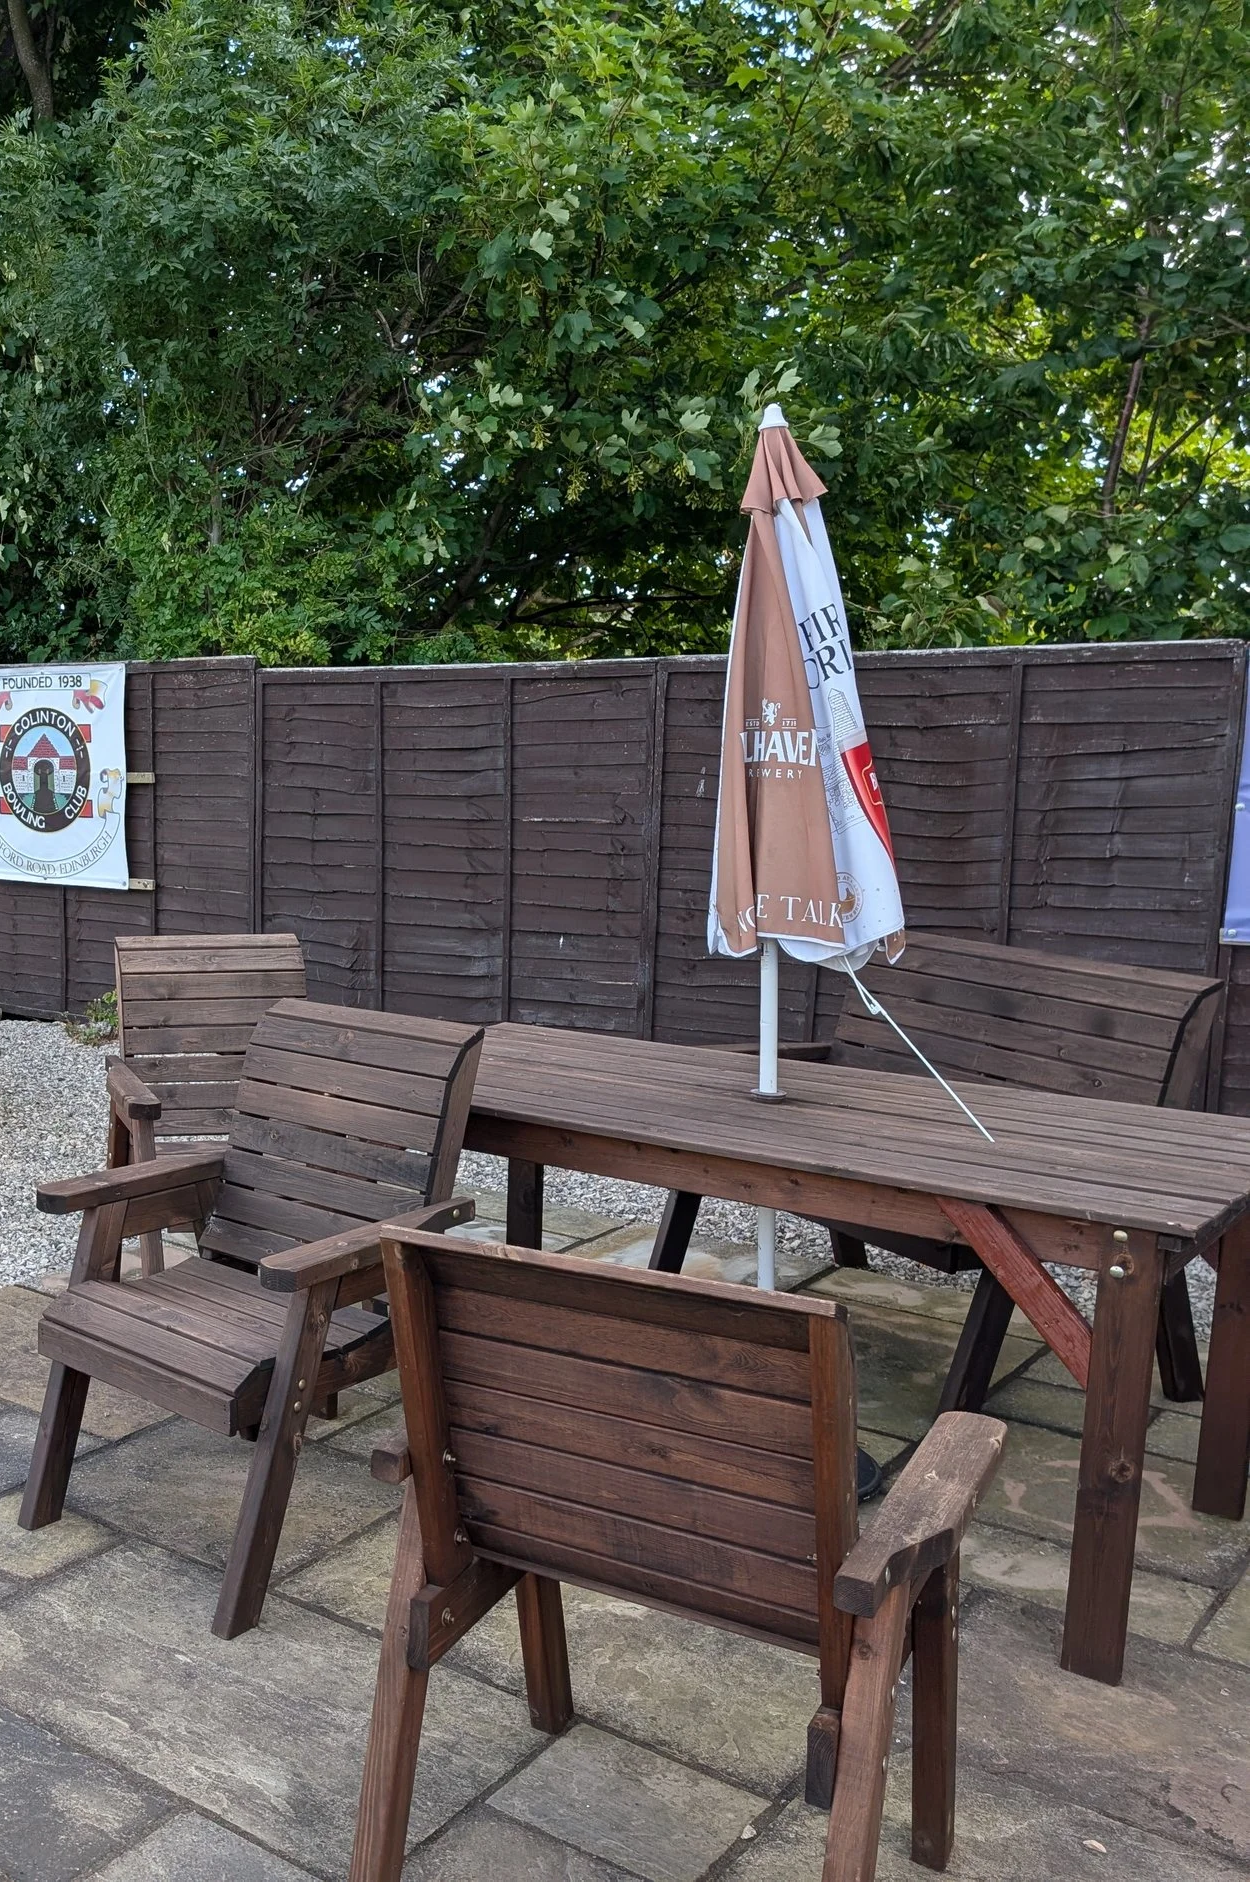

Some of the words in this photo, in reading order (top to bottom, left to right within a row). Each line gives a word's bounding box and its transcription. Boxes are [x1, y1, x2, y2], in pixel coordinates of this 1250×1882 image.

[3, 676, 52, 689] FOUNDED
[58, 675, 82, 688] 1938
[14, 711, 76, 737] COLINTON
[3, 782, 46, 829] BOWLING
[64, 785, 88, 820] CLUB
[26, 860, 57, 876] ROAD,
[59, 830, 113, 875] EDINBURGH
[780, 896, 843, 928] TALK
